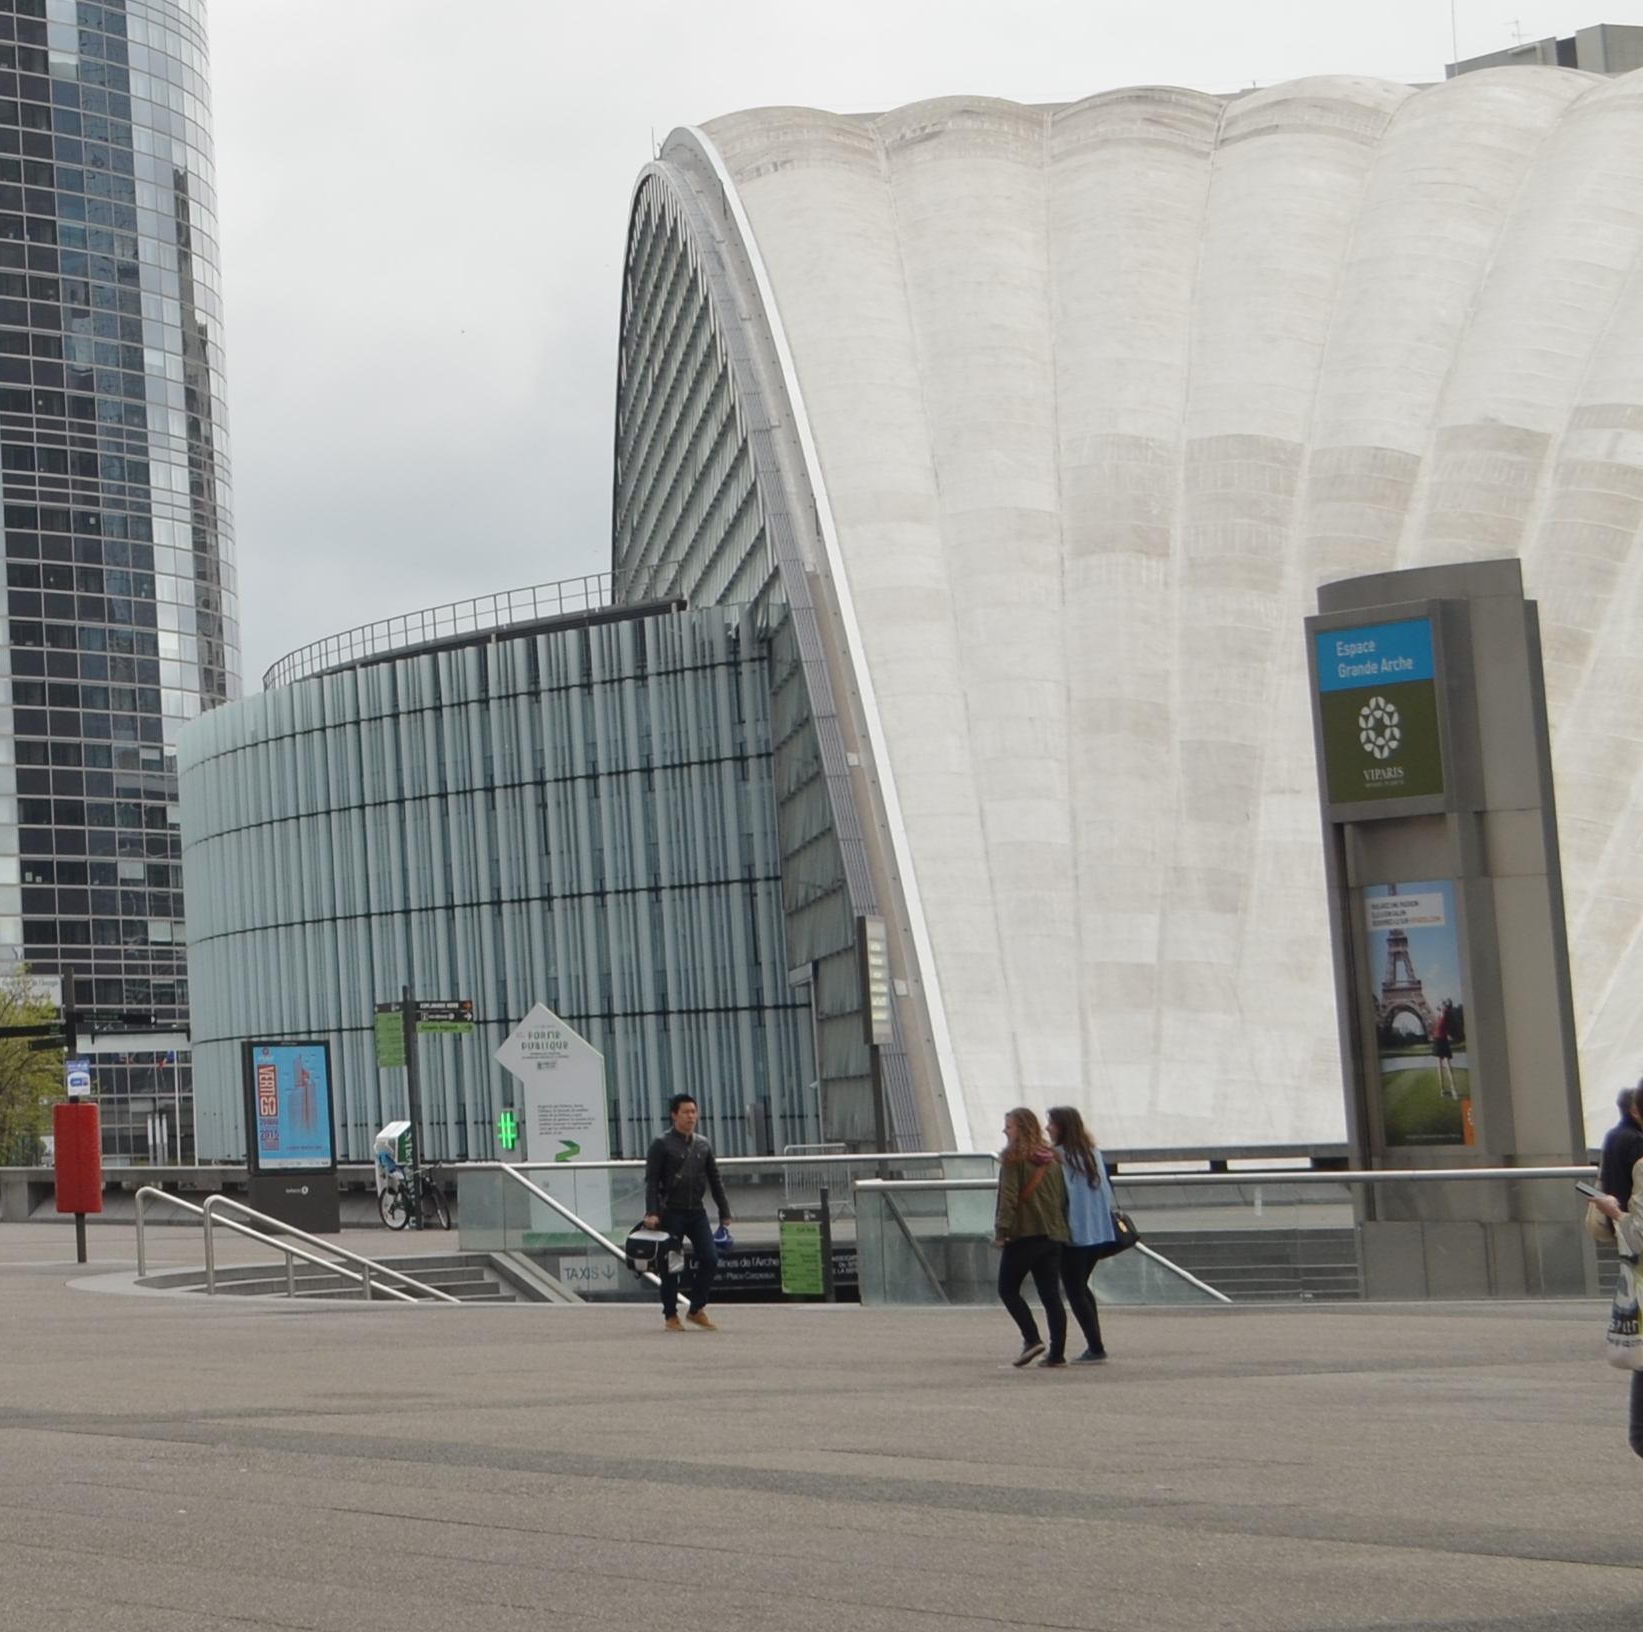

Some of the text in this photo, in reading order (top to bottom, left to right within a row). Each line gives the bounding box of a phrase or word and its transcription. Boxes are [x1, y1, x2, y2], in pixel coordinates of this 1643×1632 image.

[1336, 640, 1376, 658] Espace
[1338, 655, 1414, 678] Grande Arche
[1363, 766, 1404, 781] VIPARIS
[521, 1041, 569, 1050] PUBLIQUE
[260, 1096, 276, 1116] GO
[260, 1130, 279, 1139] 2015
[740, 1256, 751, 1267] de
[752, 1255, 780, 1266] l'Arche
[565, 1268, 600, 1280] TAXIS
[728, 1271, 744, 1280] Place
[745, 1272, 776, 1281] Carpeaux
